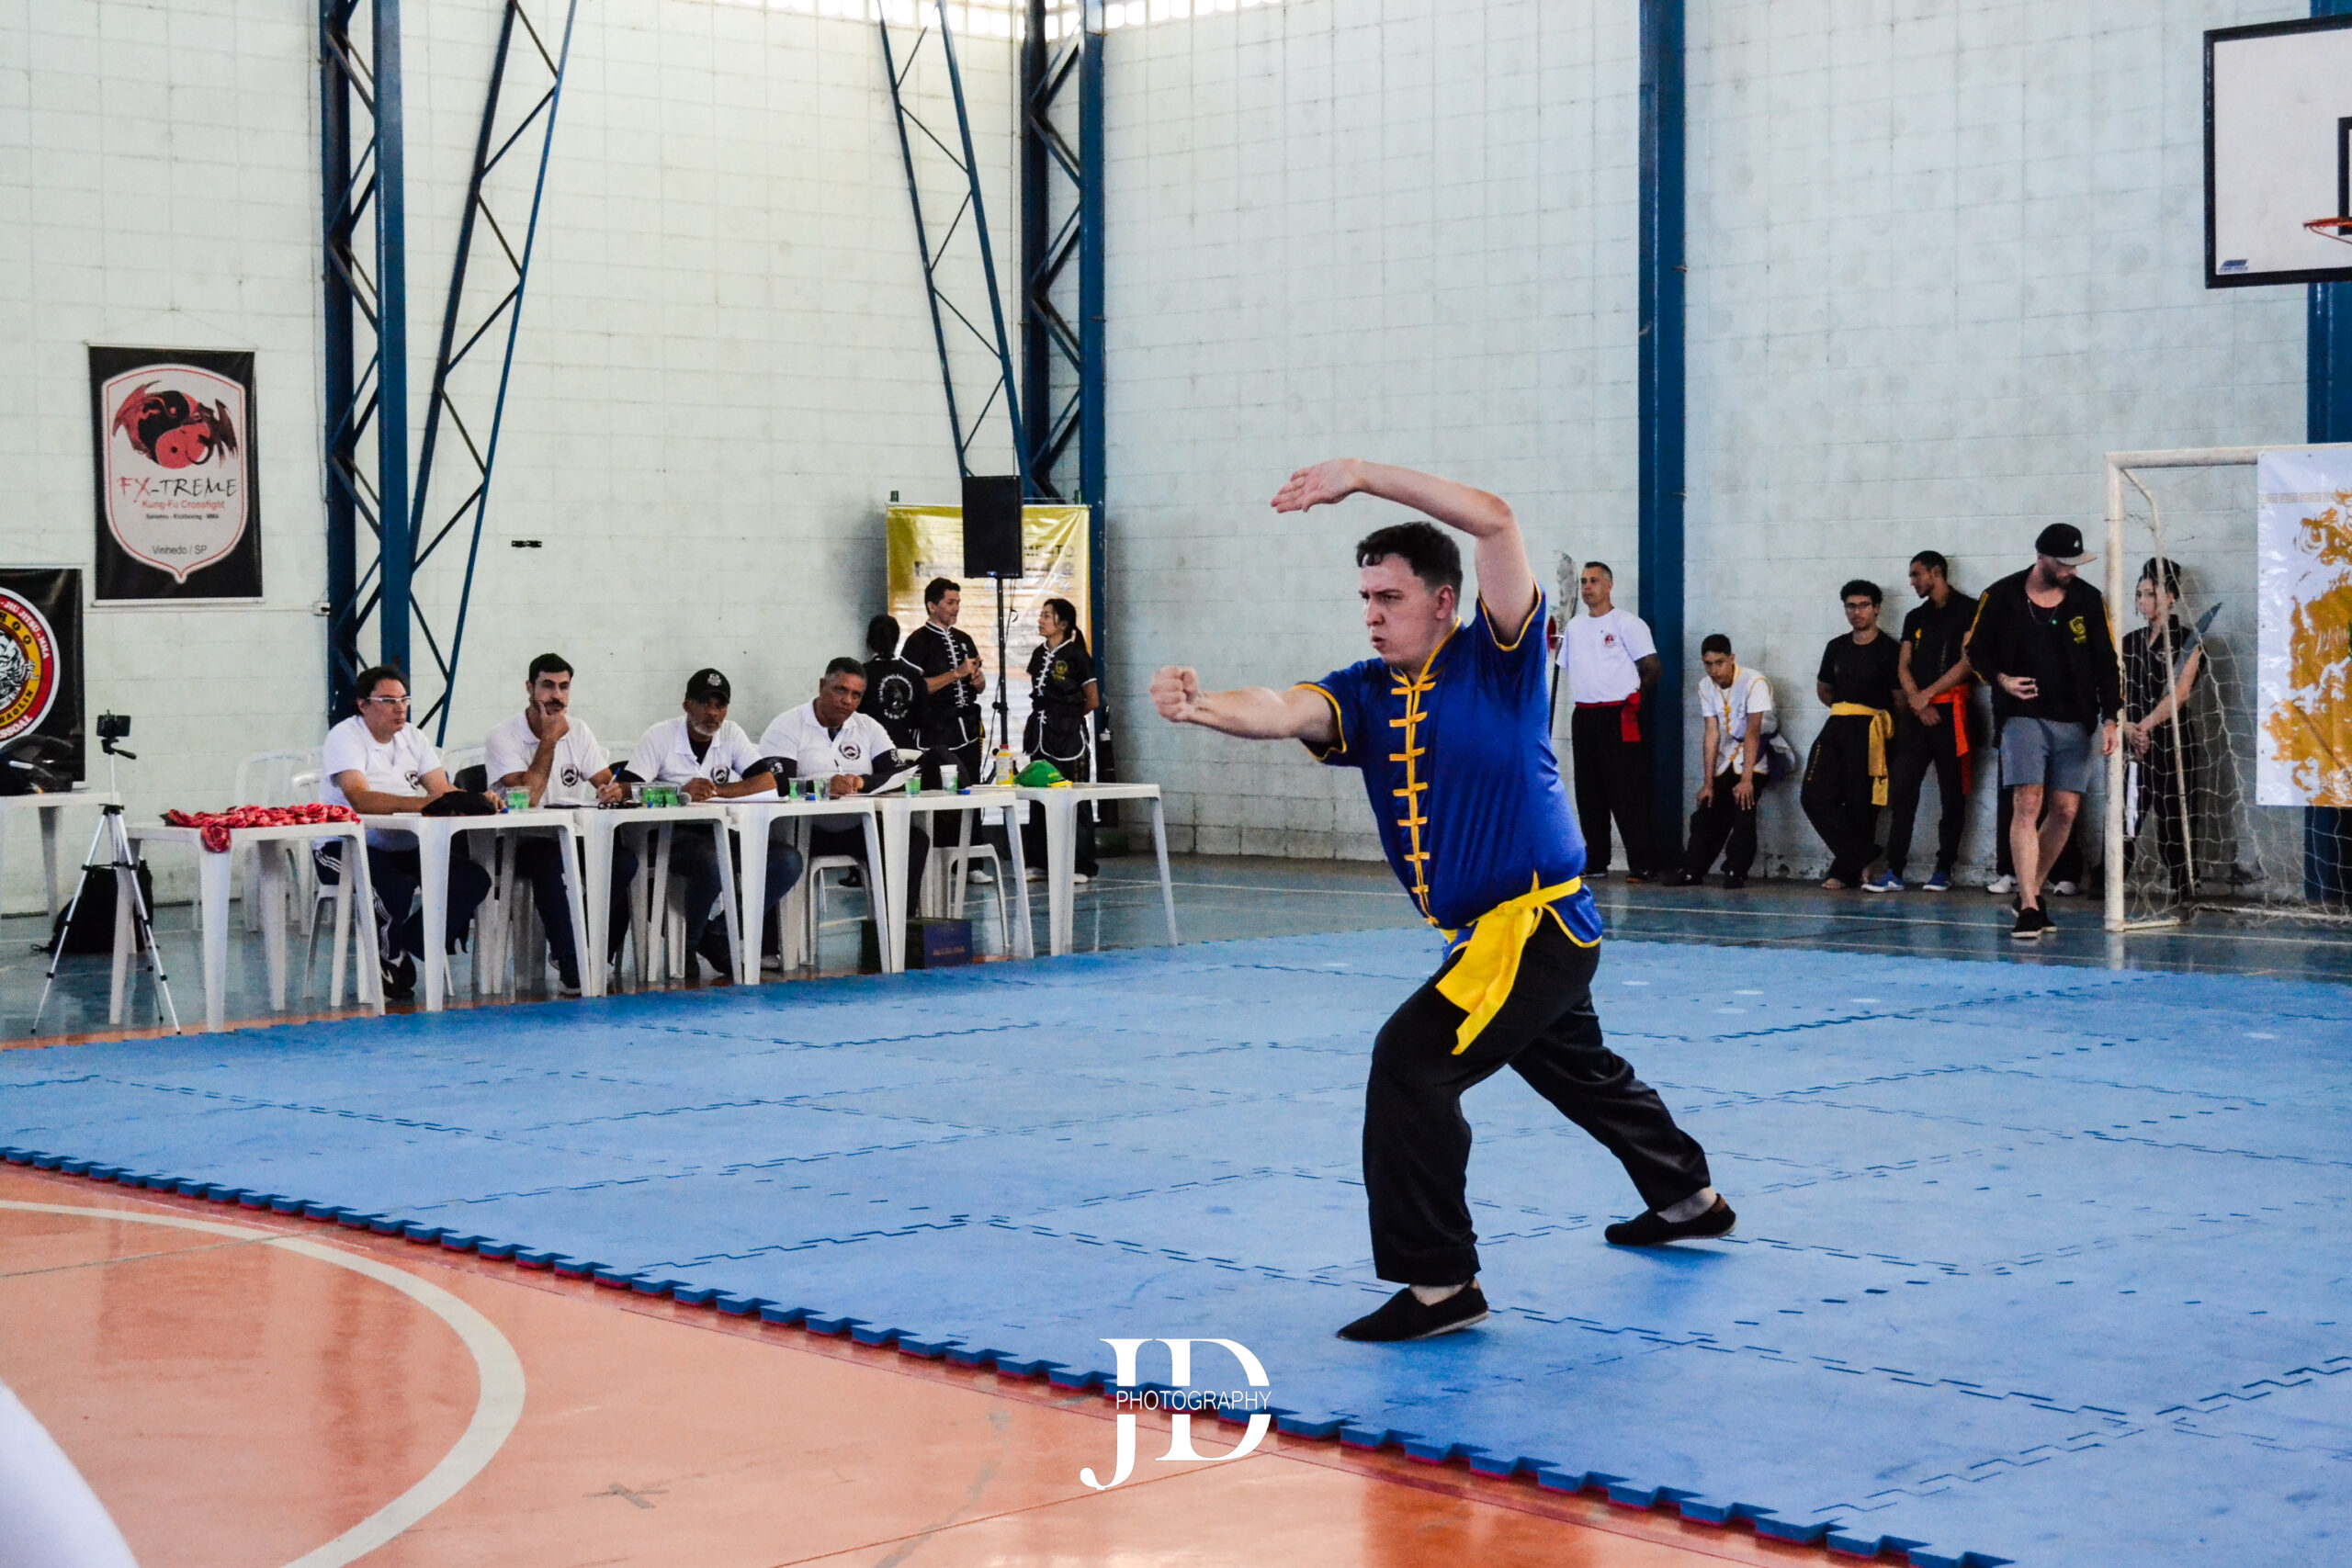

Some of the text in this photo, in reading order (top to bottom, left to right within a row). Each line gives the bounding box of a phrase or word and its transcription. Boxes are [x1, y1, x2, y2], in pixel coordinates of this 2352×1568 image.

[118, 477, 237, 502] FX-TREME
[141, 500, 225, 510] Kung-Fu Crossfight
[152, 545, 187, 555] Vinhedo
[195, 545, 208, 555] SP
[5, 601, 51, 660] JIU JITSU MMA
